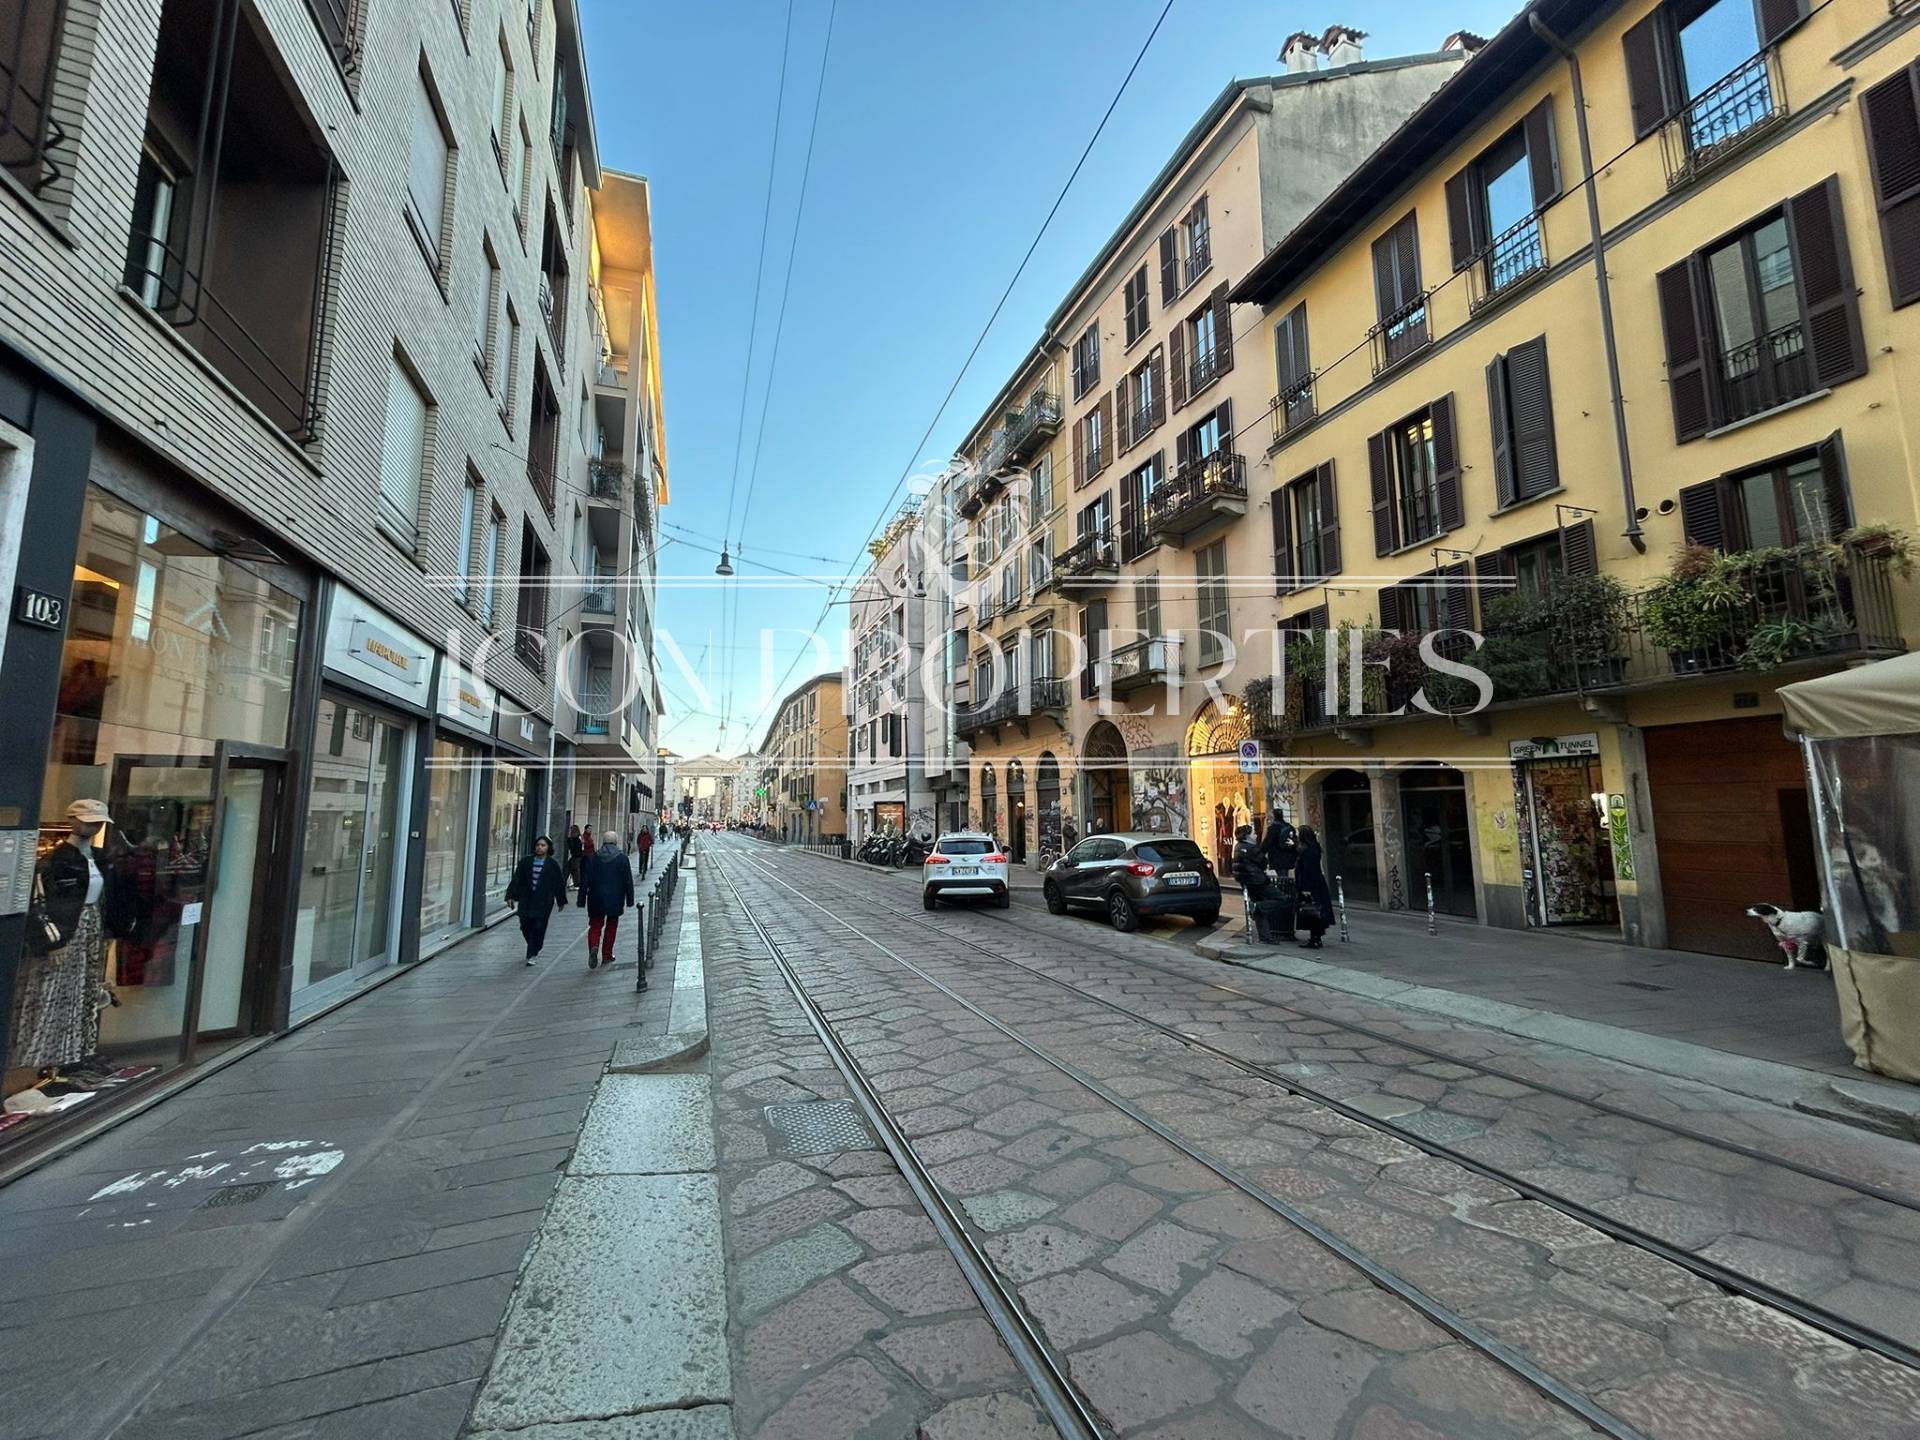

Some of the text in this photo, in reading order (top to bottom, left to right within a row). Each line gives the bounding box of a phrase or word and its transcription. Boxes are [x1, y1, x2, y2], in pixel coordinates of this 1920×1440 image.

[26, 593, 61, 624] 103
[1513, 745, 1541, 754] GREEN
[1560, 741, 1594, 749] TUNNEL
